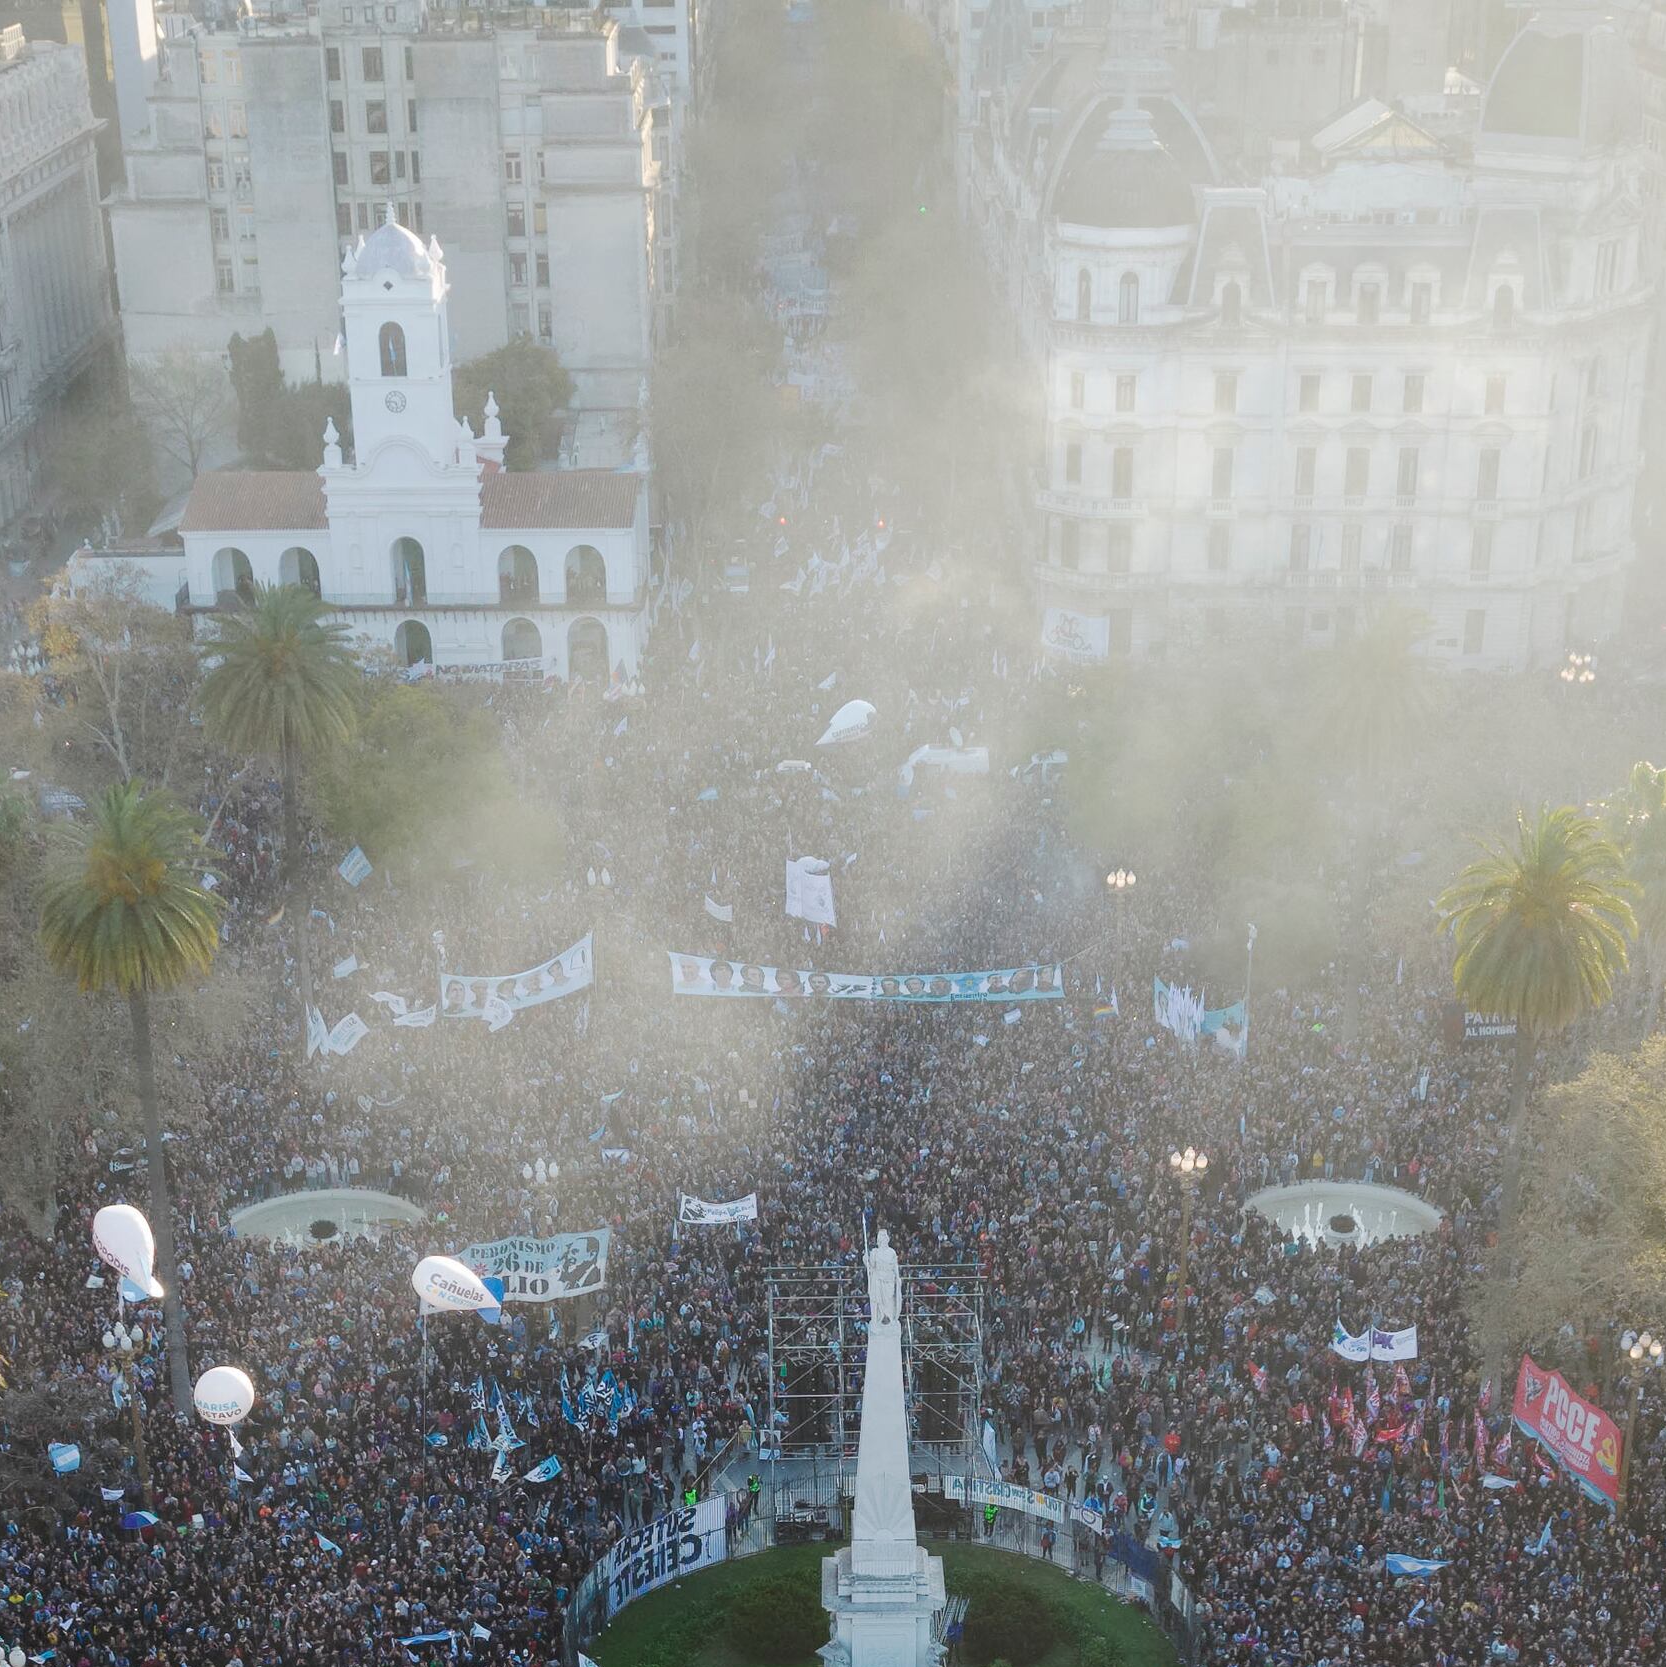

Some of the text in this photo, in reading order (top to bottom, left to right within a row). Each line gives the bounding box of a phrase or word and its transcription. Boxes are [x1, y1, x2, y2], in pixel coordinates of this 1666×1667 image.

[470, 1240, 556, 1259] PERONISMO
[493, 1252, 544, 1276] 26 DE
[430, 1273, 484, 1302] Cañuelas
[1543, 1377, 1600, 1452] PCCE
